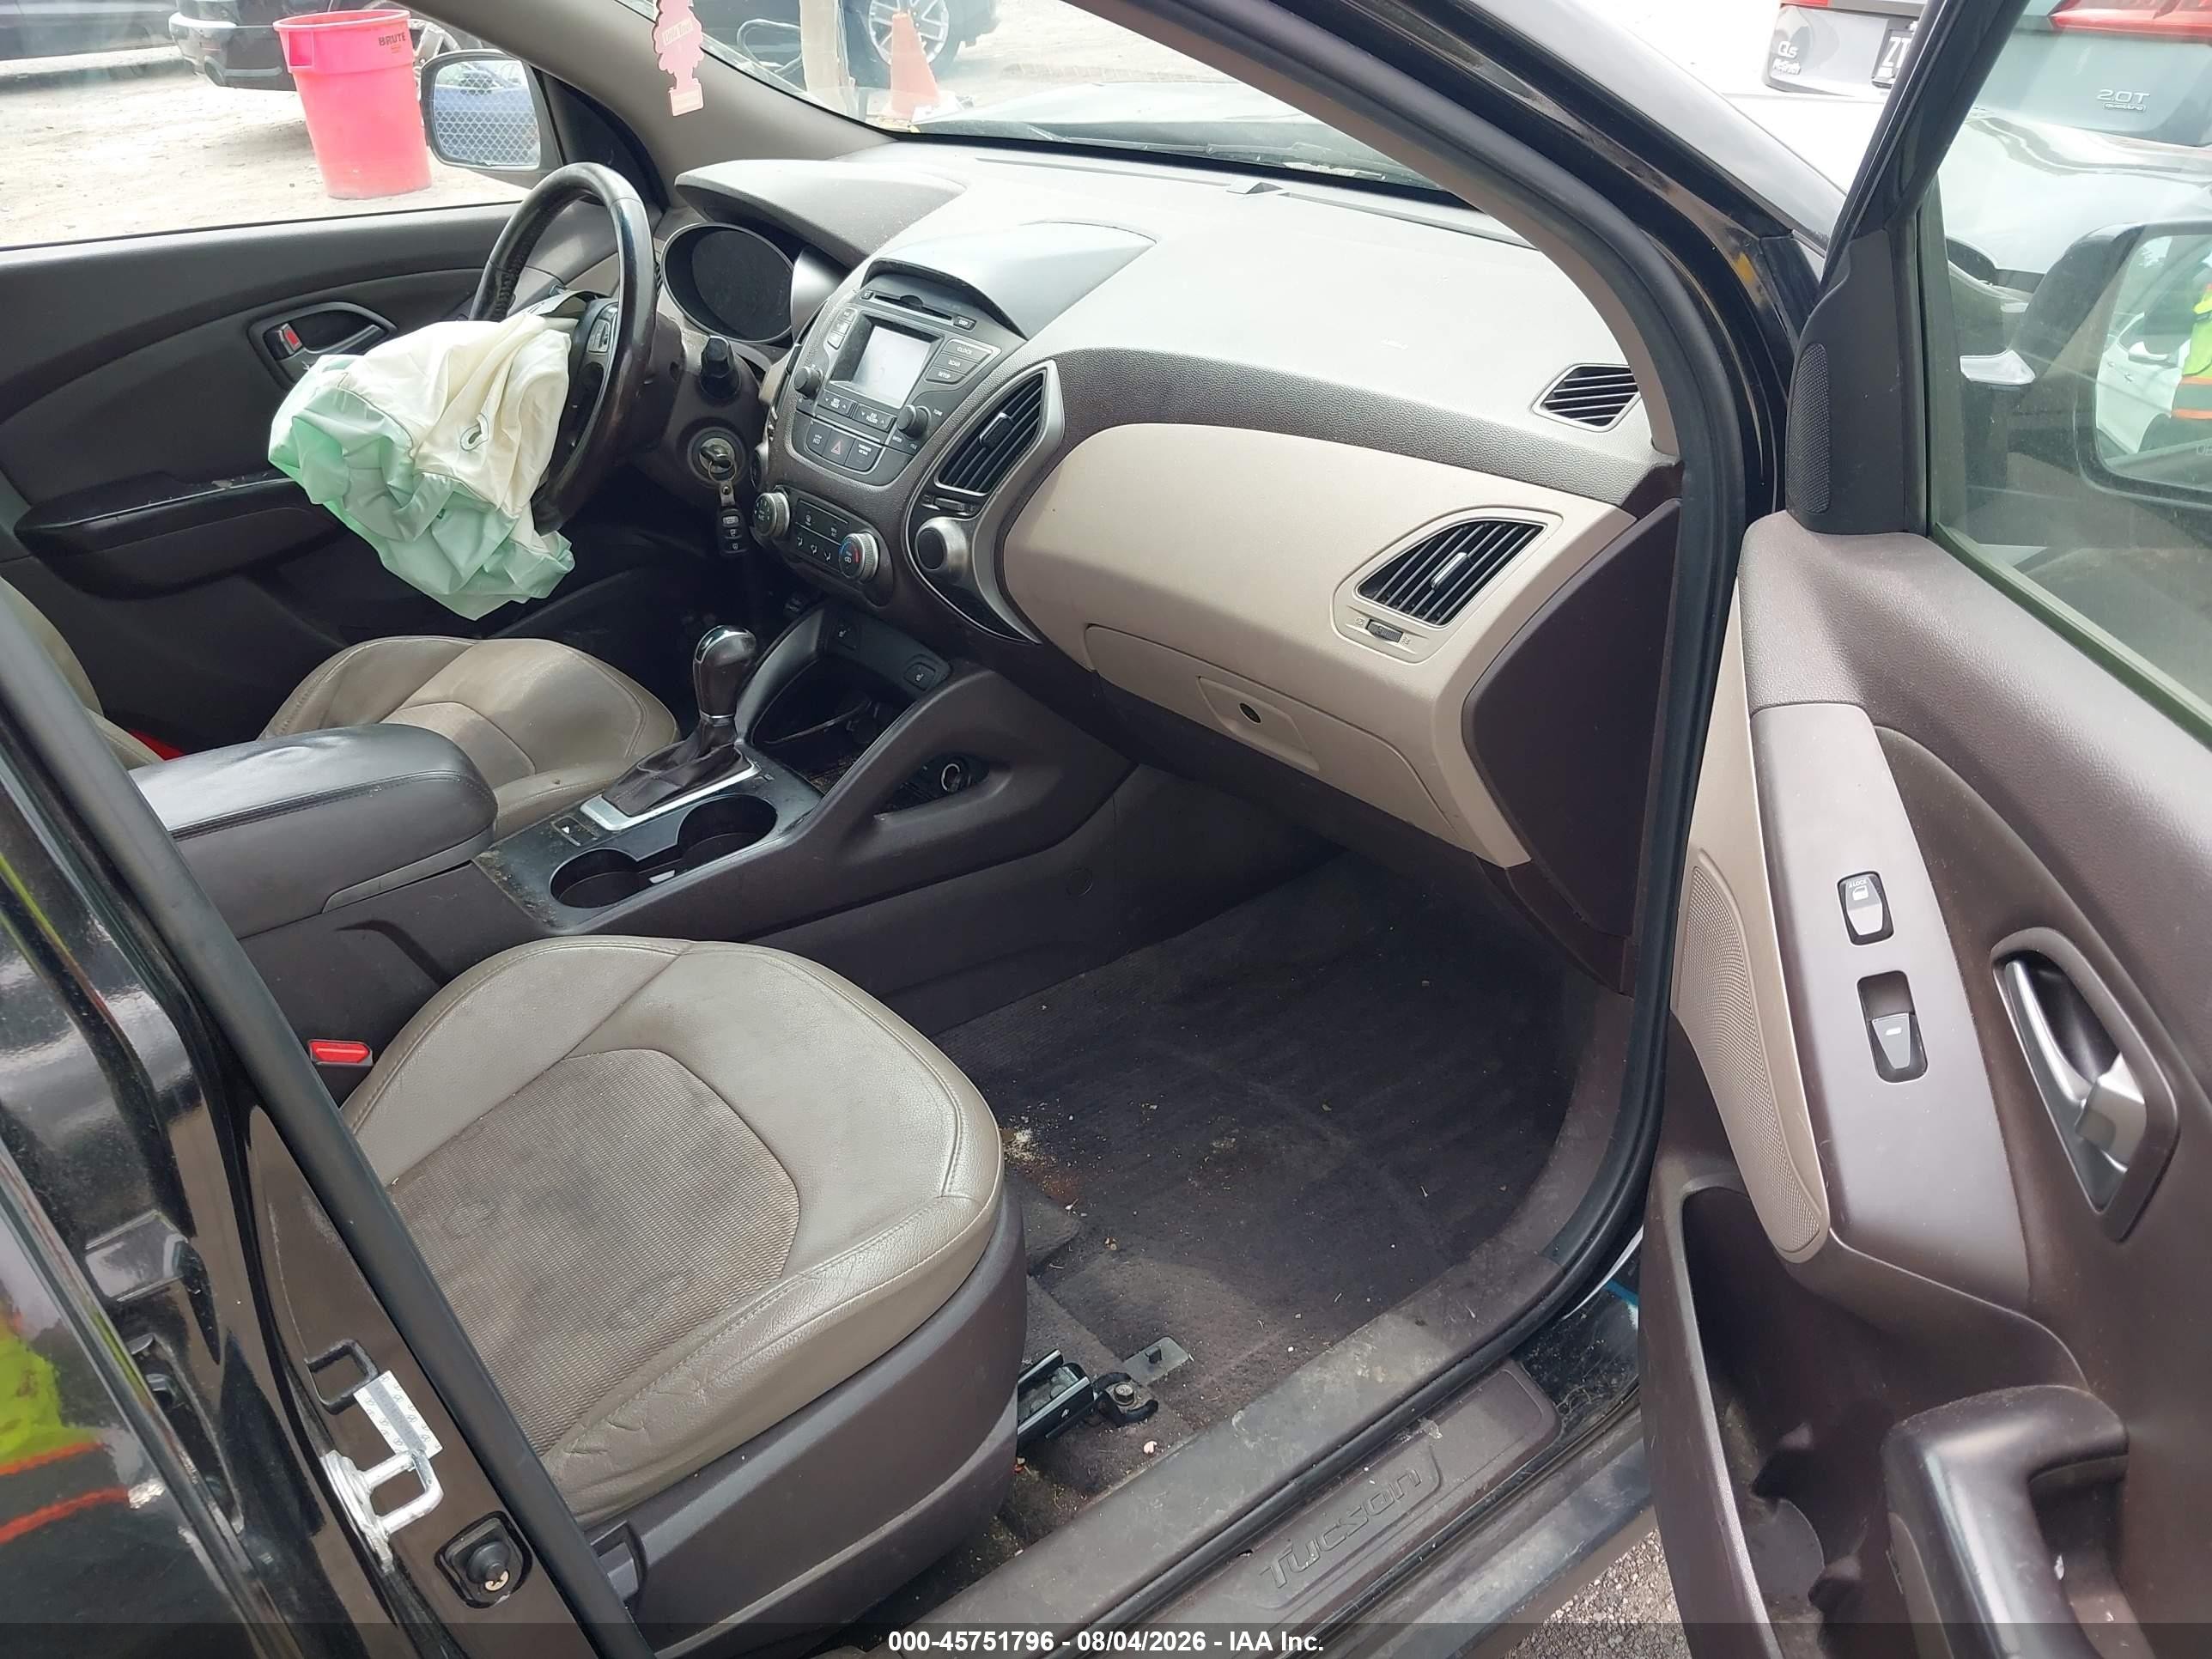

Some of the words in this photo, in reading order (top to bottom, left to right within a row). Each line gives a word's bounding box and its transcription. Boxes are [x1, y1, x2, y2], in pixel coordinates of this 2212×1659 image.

[379, 32, 405, 46] BRUTE
[2096, 88, 2150, 104] 2.0T
[1852, 878, 1868, 888] LOCK
[1258, 1468, 1422, 1589] Tucson
